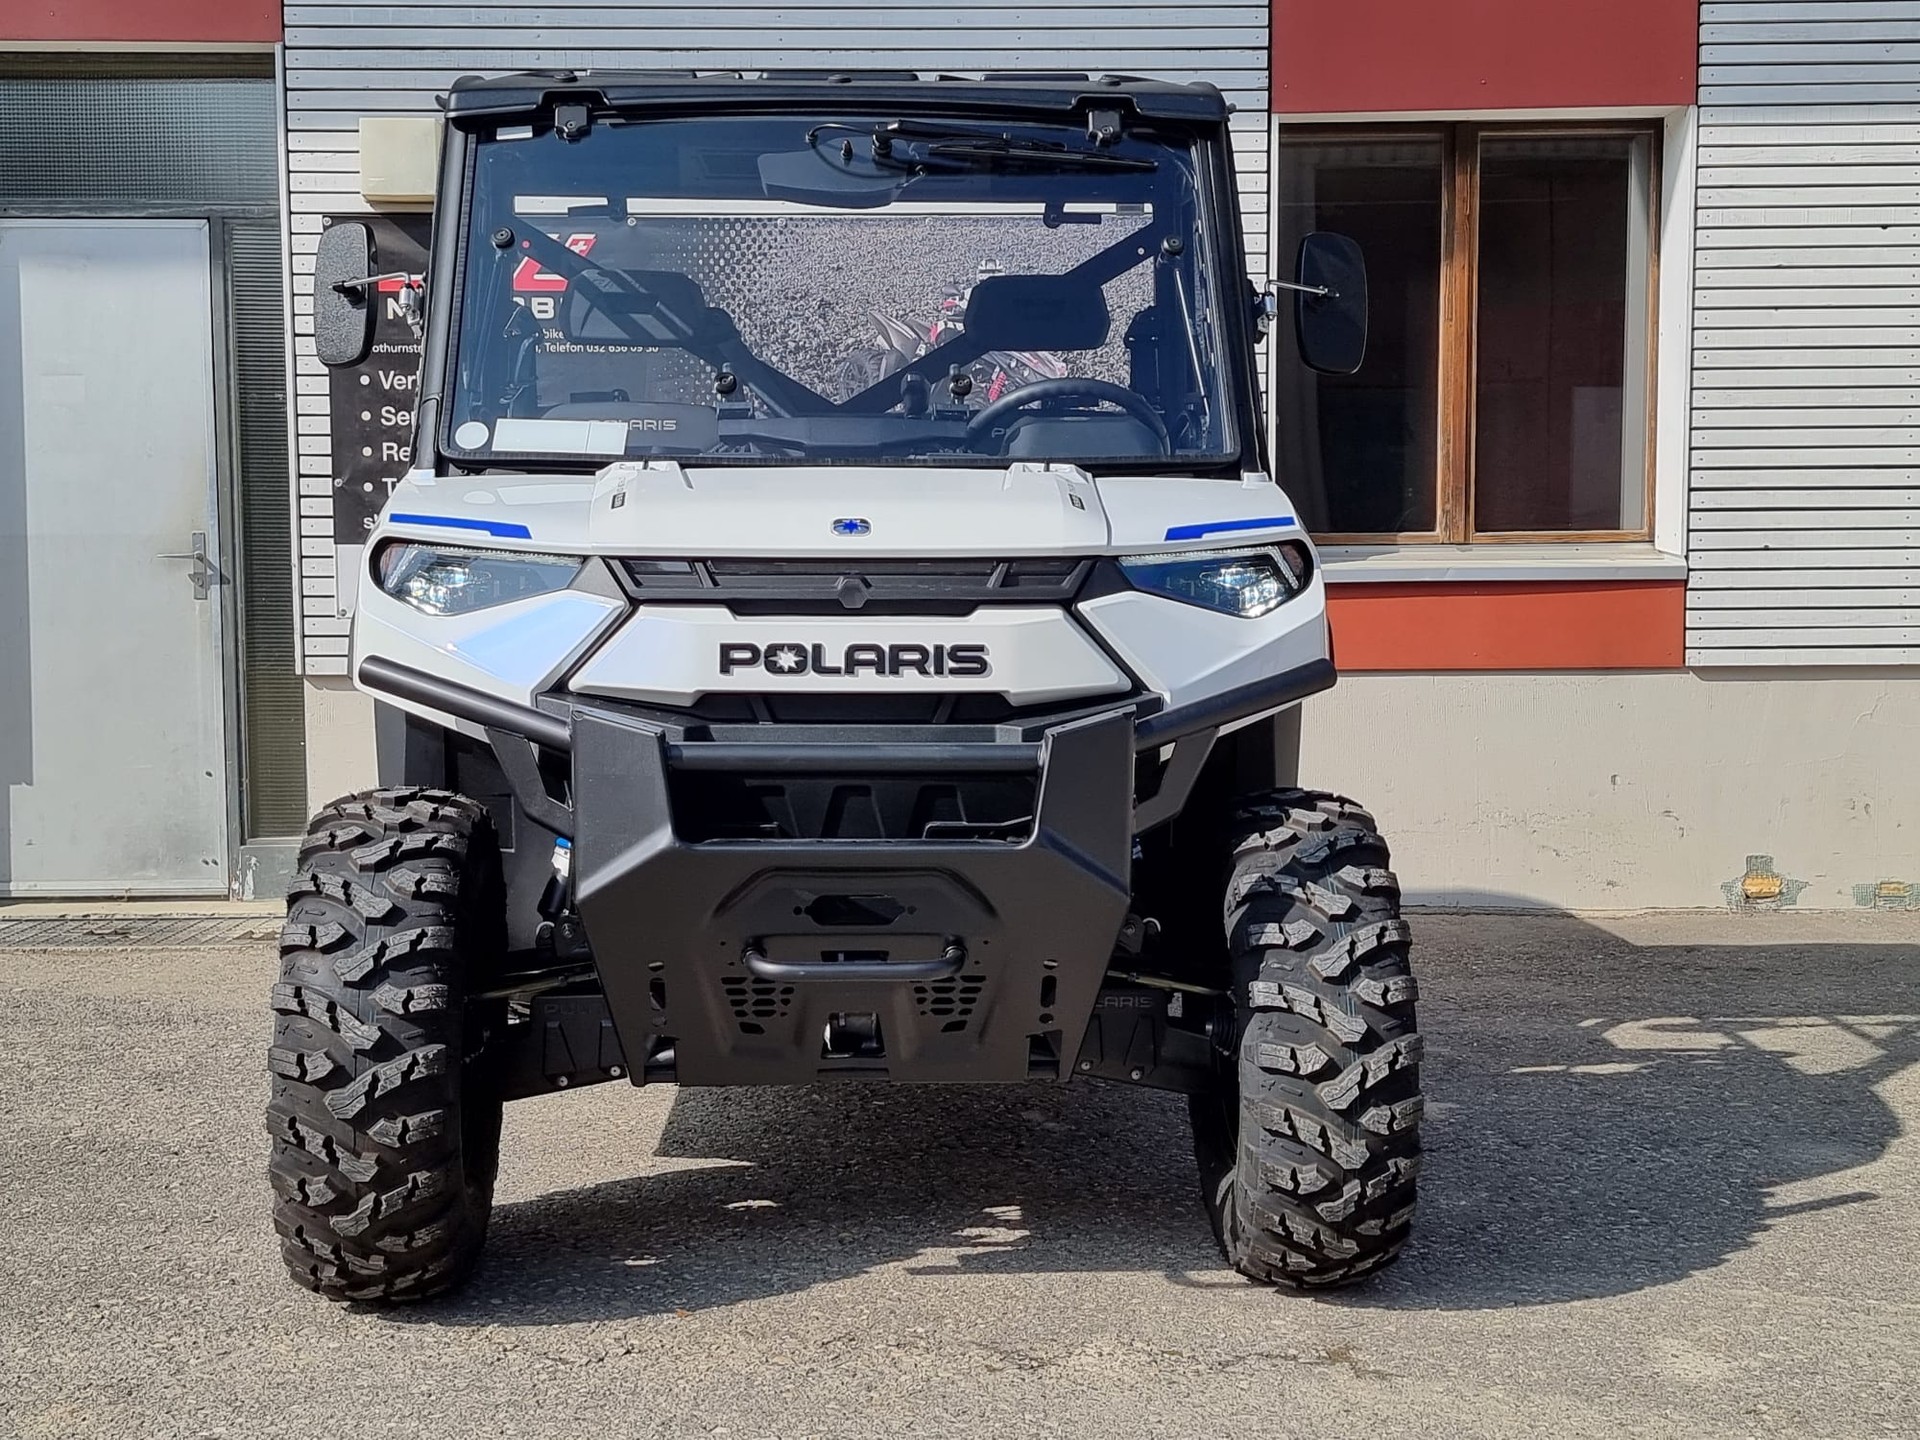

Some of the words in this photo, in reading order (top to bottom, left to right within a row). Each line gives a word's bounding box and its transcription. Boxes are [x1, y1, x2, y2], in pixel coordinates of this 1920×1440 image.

[372, 343, 421, 353] othurnstr
[544, 342, 584, 353] Telefon
[378, 370, 420, 390] Ver
[617, 419, 677, 431] ARIS
[382, 442, 411, 462] Re
[381, 478, 398, 497] T
[719, 642, 992, 677] POLARIS
[1097, 996, 1153, 1008] ARIS
